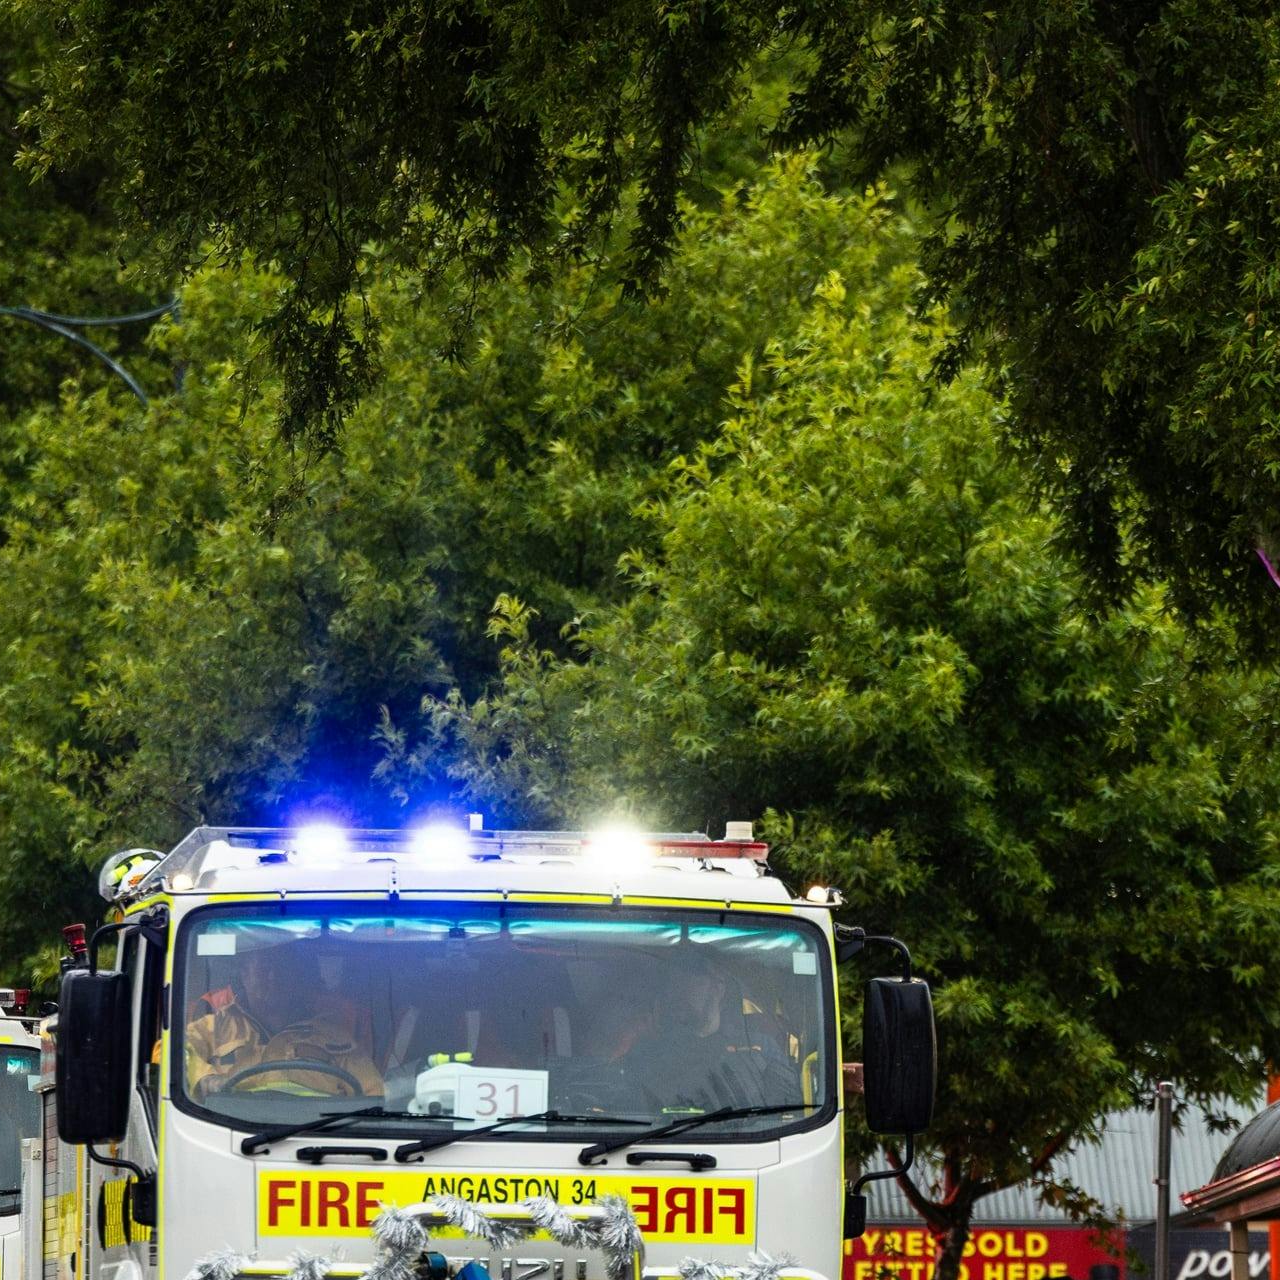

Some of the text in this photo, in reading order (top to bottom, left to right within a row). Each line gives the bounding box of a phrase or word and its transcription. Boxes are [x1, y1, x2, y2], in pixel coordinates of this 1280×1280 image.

[475, 1082, 525, 1118] 31
[268, 1177, 597, 1229] FIRE ANGASTON 34
